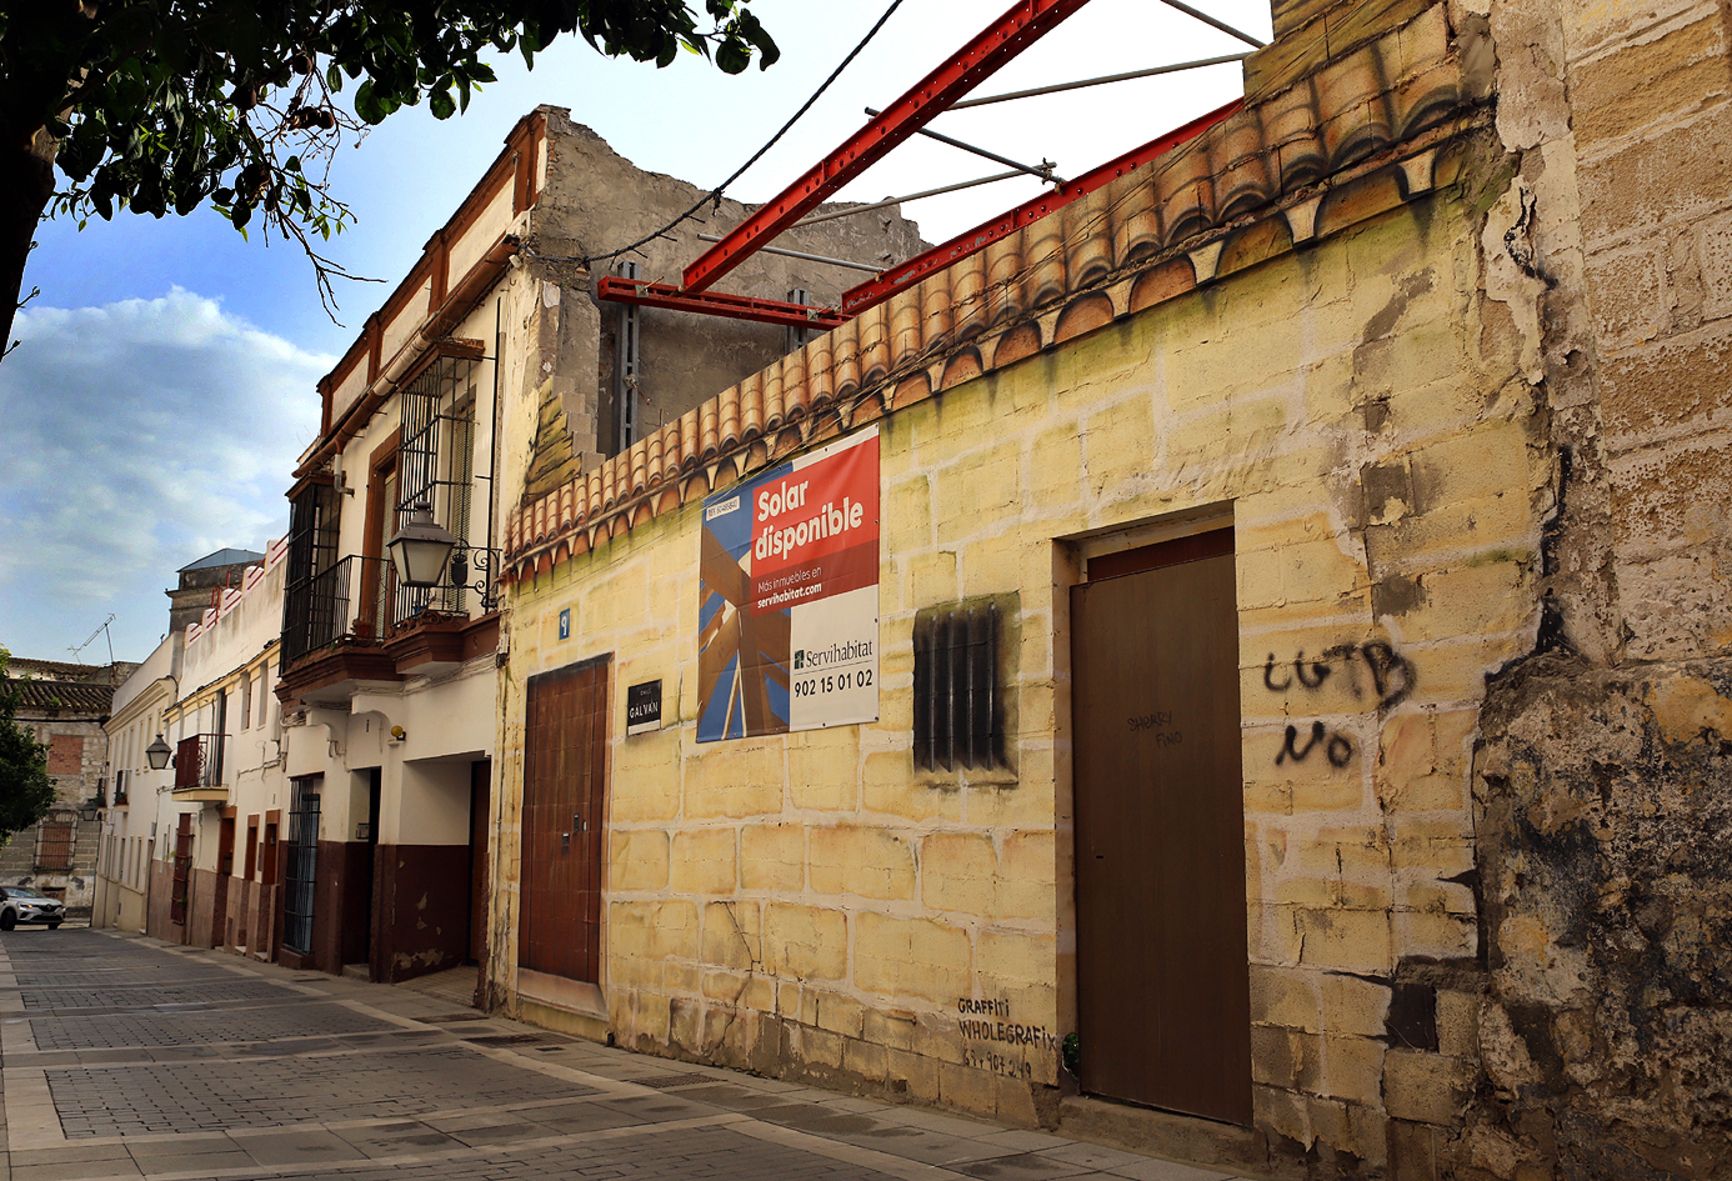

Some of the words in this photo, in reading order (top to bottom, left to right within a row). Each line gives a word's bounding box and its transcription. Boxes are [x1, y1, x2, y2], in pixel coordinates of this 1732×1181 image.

[758, 480, 809, 522] Solar
[755, 496, 864, 561] disponible
[772, 570, 811, 589] inmuebles
[811, 566, 822, 578] en
[757, 583, 822, 609] servihabitat.com
[561, 615, 567, 636] 9
[806, 640, 873, 668] Servihabitat
[794, 679, 816, 698] 902
[820, 675, 833, 694] 15
[837, 672, 852, 691] 01
[856, 668, 873, 688] 02
